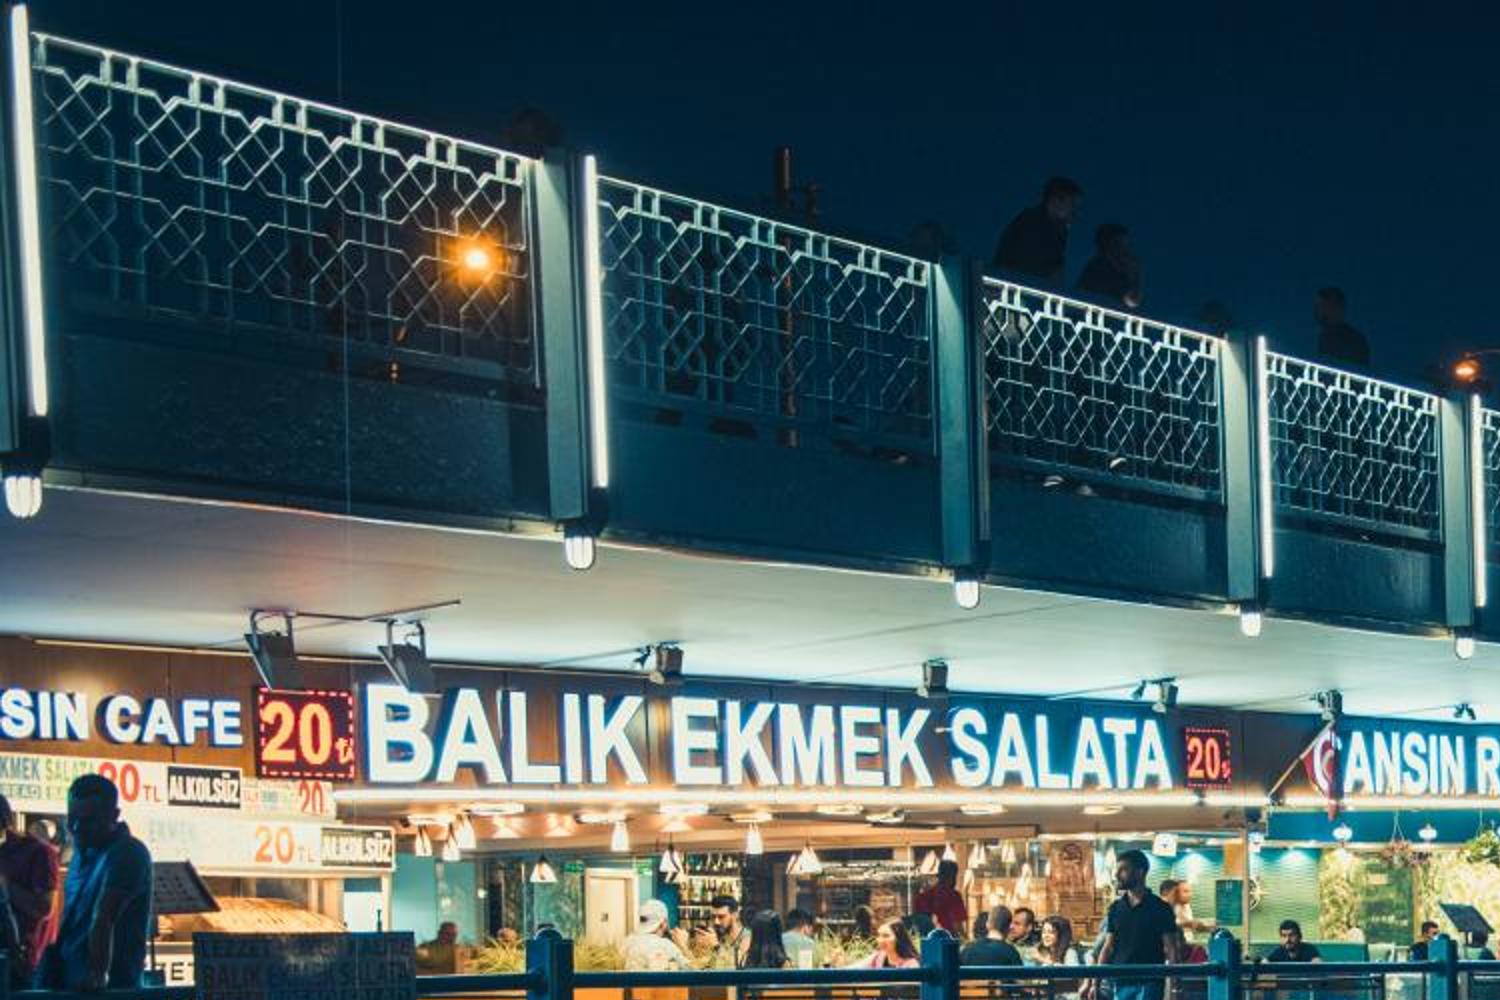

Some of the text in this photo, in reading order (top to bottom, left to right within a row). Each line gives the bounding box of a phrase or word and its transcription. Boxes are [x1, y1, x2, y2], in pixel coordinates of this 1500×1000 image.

[0, 687, 243, 745] SIN CAFE
[261, 700, 332, 765] 20
[366, 683, 1173, 789] BALIK EKMEK SALATA
[1188, 736, 1220, 779] 20
[169, 772, 240, 804] ALKOLSÜZ
[255, 825, 294, 864] 20
[322, 831, 392, 862] ALKOLSÜZ
